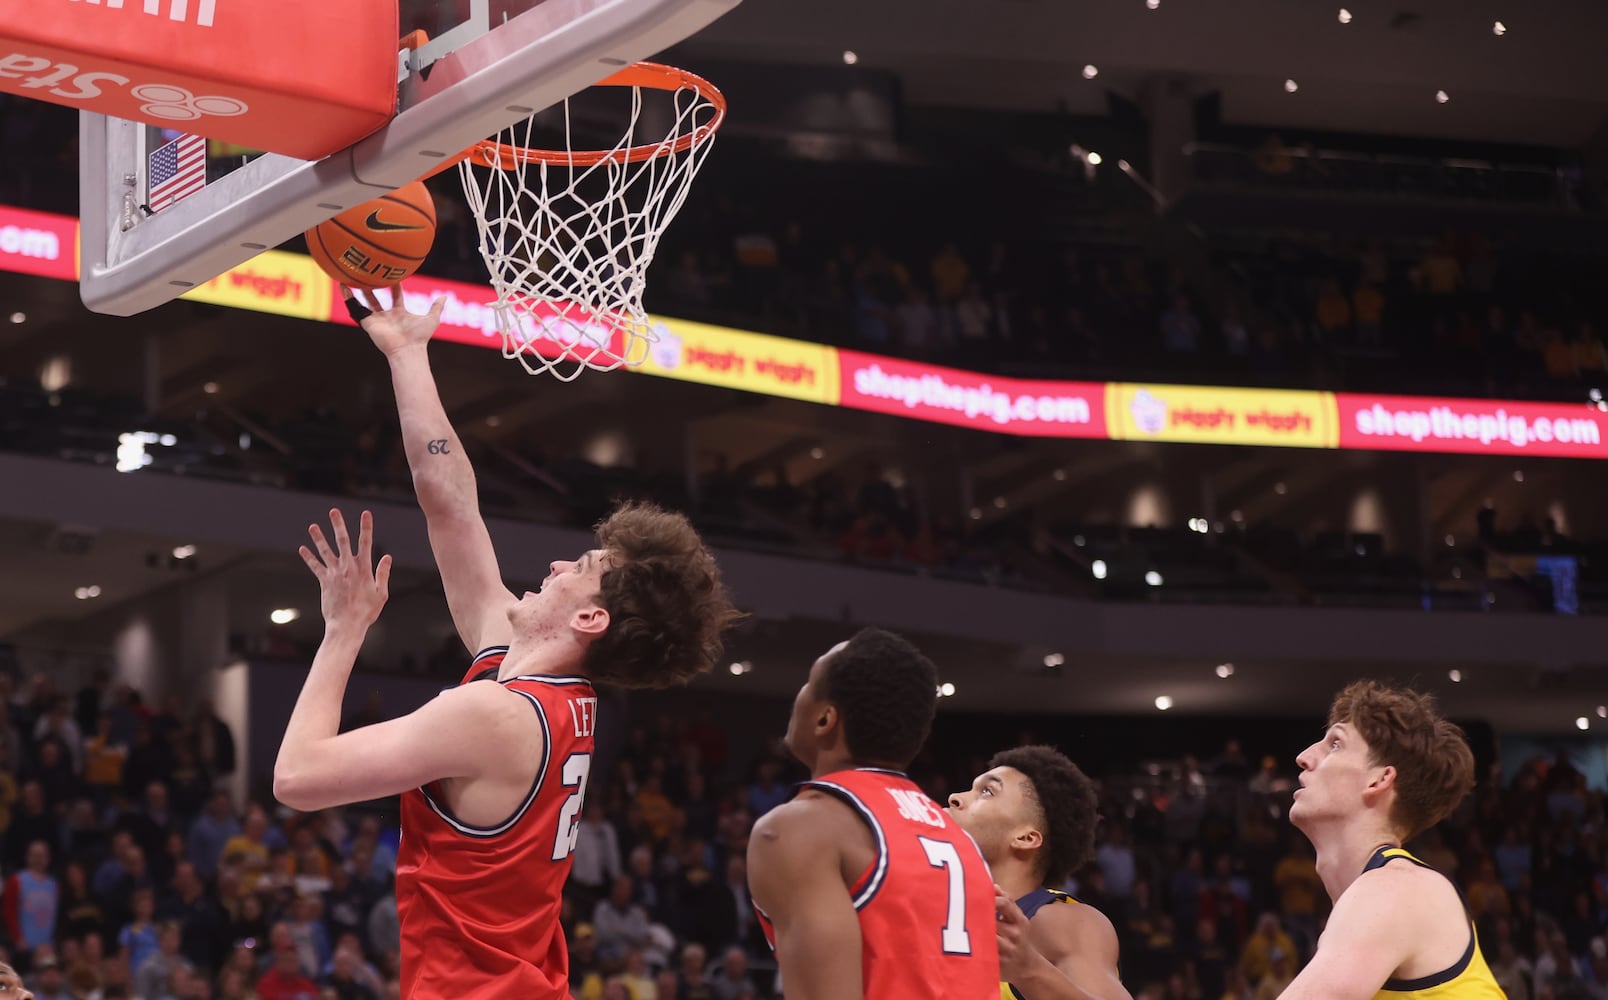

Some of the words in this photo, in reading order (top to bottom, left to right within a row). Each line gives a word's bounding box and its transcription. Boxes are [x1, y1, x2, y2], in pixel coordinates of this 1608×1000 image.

[0, 225, 59, 260] om
[343, 245, 407, 280] ELITE
[854, 363, 1090, 424] shopthepig.com
[1356, 402, 1600, 447] shopthepig.com
[552, 752, 591, 861] 2
[917, 835, 972, 956] 7
